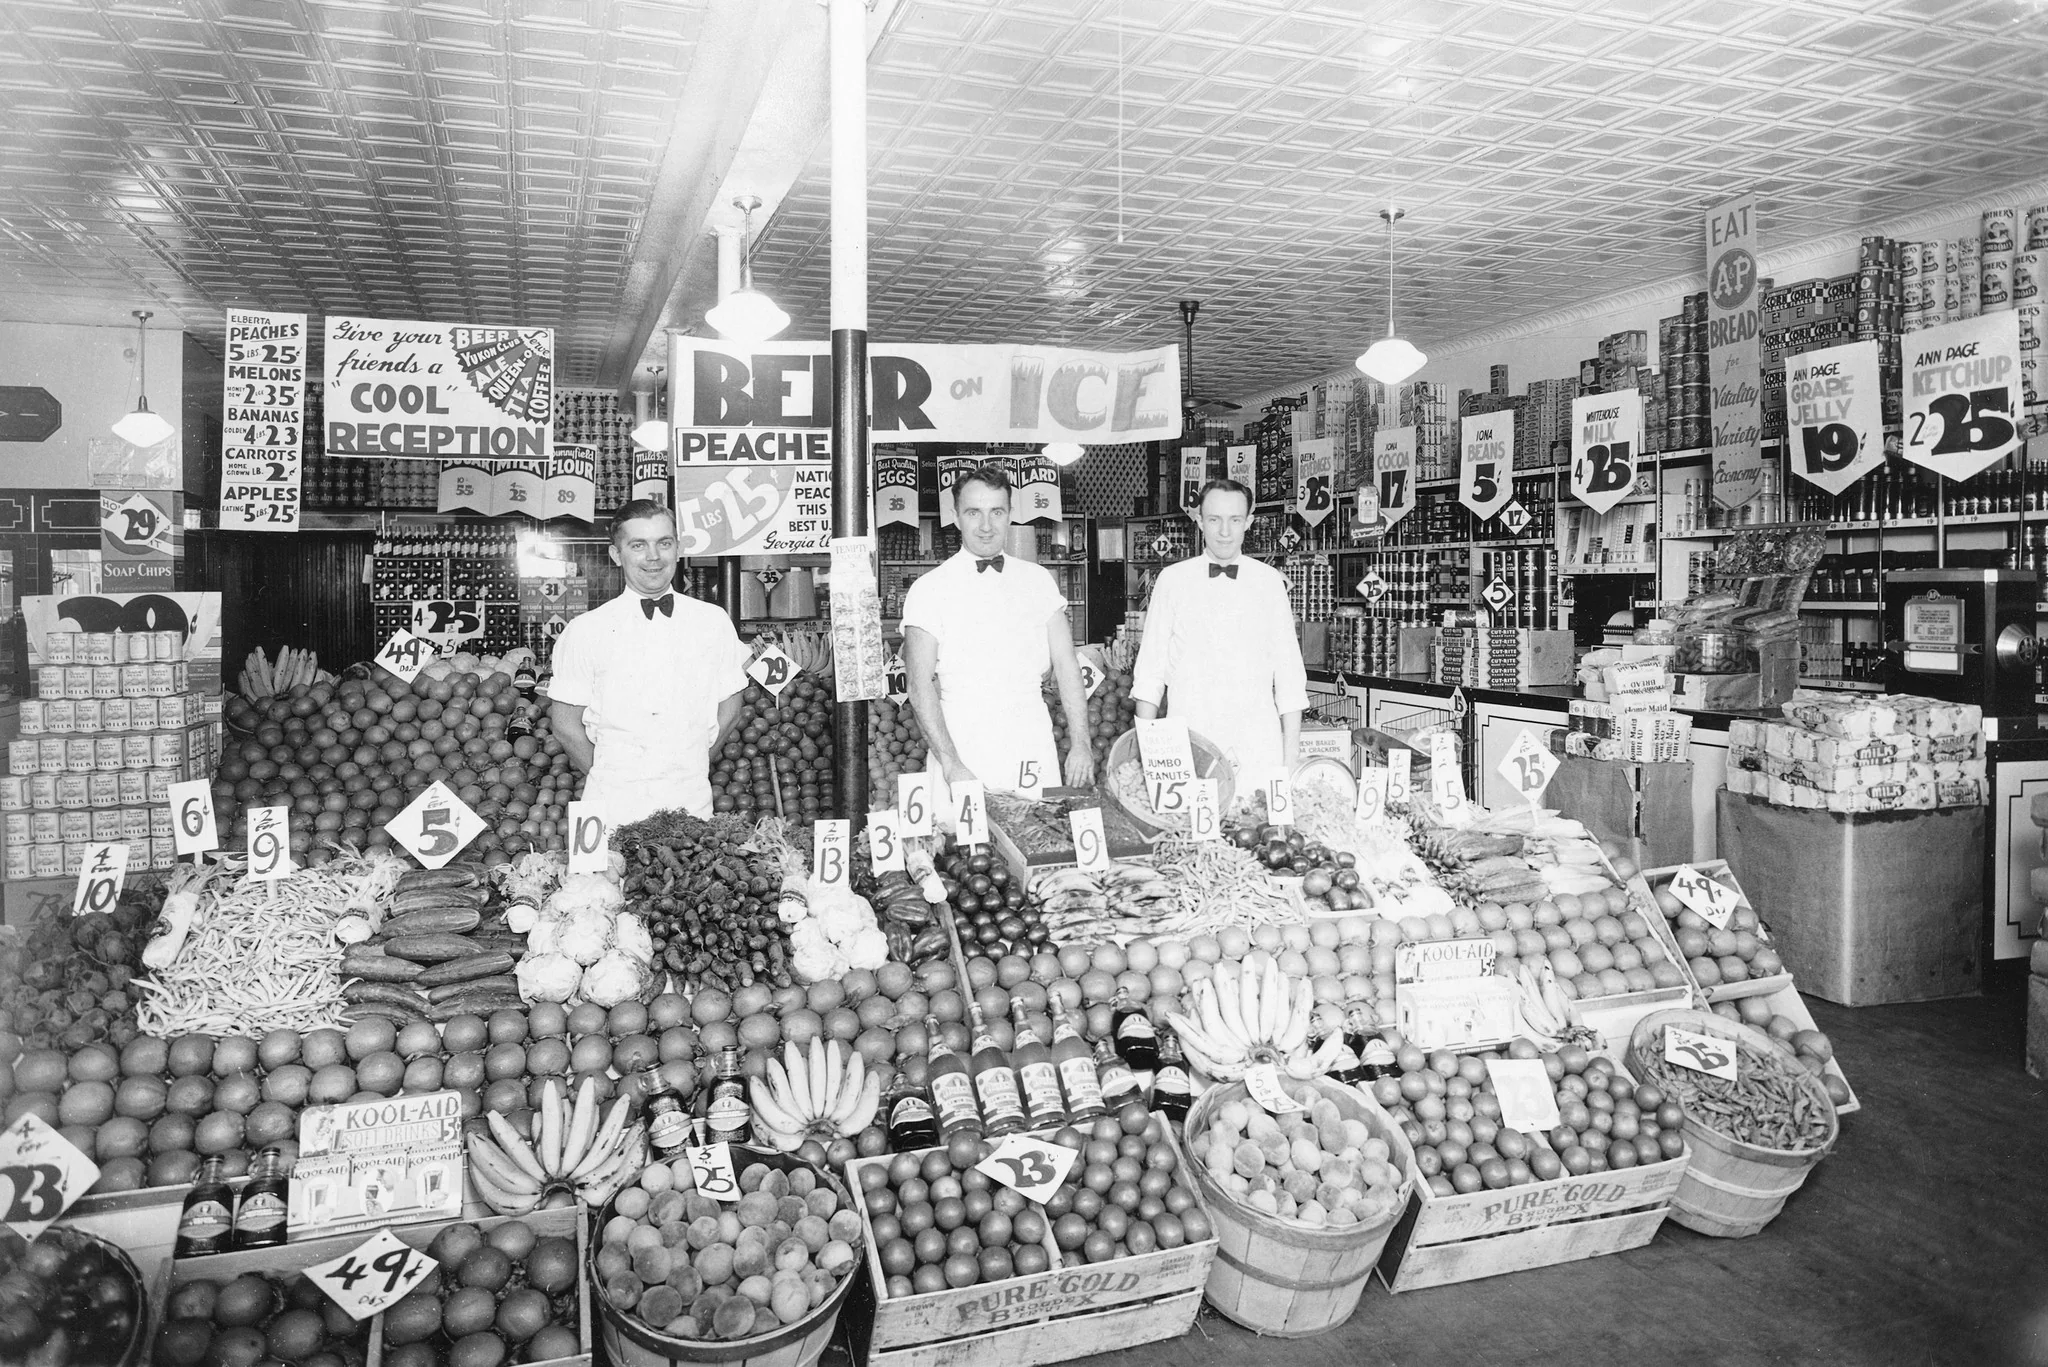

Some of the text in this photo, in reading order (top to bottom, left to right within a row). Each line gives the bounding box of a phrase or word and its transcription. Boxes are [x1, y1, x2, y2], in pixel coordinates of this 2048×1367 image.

[1712, 205, 1751, 247] EAT
[1714, 255, 1751, 299] A&P
[1790, 298, 1813, 306] FLAKES
[1828, 293, 1852, 302] FLAKES
[1765, 304, 1788, 313] FLAKES
[231, 315, 271, 325] ELBERTA
[1710, 310, 1757, 349] BREAD
[230, 324, 299, 341] PEACHES
[333, 321, 442, 353] Give your
[456, 329, 510, 349] BEER
[230, 344, 245, 361] 5
[460, 338, 520, 367] YUKON CLUB
[524, 330, 550, 357] Serve
[336, 348, 443, 377] friends a
[1725, 354, 1739, 375] for
[1915, 342, 1981, 368] ANN PAGE
[229, 365, 301, 382] MELONS
[475, 356, 509, 391] ALE
[488, 349, 533, 400] QUEEN-O
[1792, 362, 1840, 382] ANN PAGE
[1912, 355, 2012, 397] KETCHUP
[243, 384, 256, 404] 2
[331, 380, 458, 414] "COOL"
[504, 377, 533, 413] TEA
[527, 362, 550, 418] COFFEE
[950, 376, 982, 400] ON
[1009, 355, 1168, 432] ICE
[1712, 382, 1759, 409] Vitality
[1791, 375, 1854, 404] GRAPE
[228, 408, 299, 423] BANANAS
[1586, 406, 1620, 423] WHITEHOUSE
[1791, 397, 1852, 426] JELLY
[244, 425, 256, 444] 4
[329, 422, 545, 455] RECEPTION
[1476, 429, 1493, 441] IONA
[1583, 421, 1617, 445] MILK
[1713, 421, 1760, 448] Variety
[1910, 412, 1926, 446] 2
[225, 448, 297, 461] CARROTS
[682, 432, 832, 461] PEACHE
[1467, 441, 1505, 462] BEANS
[636, 450, 656, 464] Mild
[877, 458, 916, 474] Best Quality
[1377, 451, 1409, 471] COCOA
[252, 467, 264, 476] LB.
[547, 458, 594, 480] FLOUR
[878, 470, 916, 486] EGGS
[1021, 468, 1057, 482] LARD
[1184, 466, 1200, 479] OLEO
[1231, 463, 1250, 475] CANDY
[1574, 458, 1583, 485] 4
[1714, 460, 1761, 485] Economy
[224, 486, 298, 502] APPLES
[557, 489, 575, 503] 89
[1299, 486, 1306, 500] 3
[244, 504, 256, 522] 5
[797, 504, 827, 515] THIS
[678, 498, 711, 554] 5
[701, 509, 723, 529] LBS
[789, 520, 817, 531] BEST
[763, 531, 814, 552] Georgia
[104, 563, 172, 577] SOAP CHIPS
[763, 571, 779, 584] 35
[545, 583, 559, 596] 31
[1490, 582, 1506, 603] 5
[414, 607, 423, 626] 4
[549, 622, 565, 635] 10
[890, 654, 898, 665] 4
[1337, 681, 1346, 696] 15
[1454, 695, 1464, 713] 15
[1625, 704, 1668, 714] Home Maid
[1672, 730, 1680, 757] BREAD
[1861, 745, 1893, 759] MILK
[1148, 758, 1182, 768] JUMBO
[1146, 770, 1190, 780] PEANUTS
[430, 787, 439, 799] 2
[1871, 786, 1904, 798] MILK
[261, 809, 273, 822] 2
[828, 822, 837, 833] 2
[93, 846, 111, 865] 4
[1423, 942, 1493, 962] KOOL-AID
[346, 1096, 459, 1130] KOOL-AID
[346, 1116, 462, 1147] SOFT DRINKS 5¢
[353, 1156, 405, 1173] KOOL-AID
[408, 1151, 461, 1168] KOOL-AID
[295, 1165, 348, 1180] KOOL-AID
[1483, 1188, 1555, 1223] PURE
[1562, 1183, 1626, 1203] GOLD
[956, 1272, 1141, 1324] PURE GOLD
